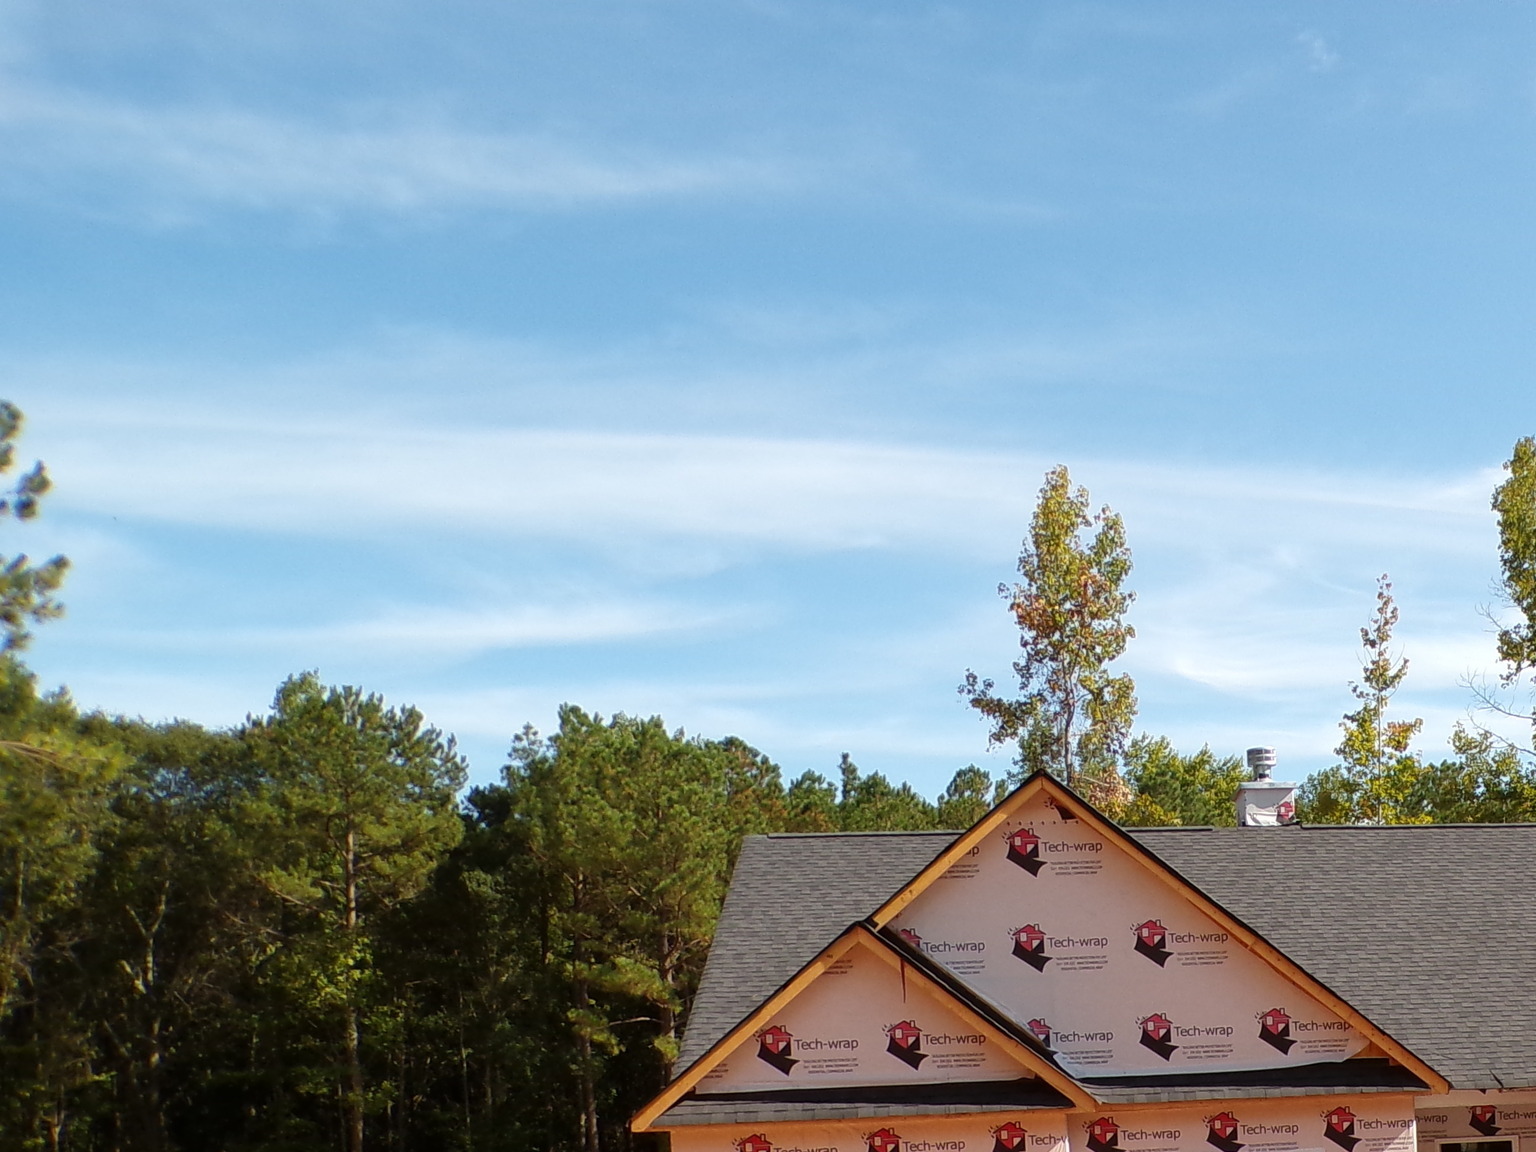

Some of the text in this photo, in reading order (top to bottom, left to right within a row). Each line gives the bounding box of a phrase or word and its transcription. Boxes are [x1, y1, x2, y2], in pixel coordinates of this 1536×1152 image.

[1042, 841, 1103, 853] Tech-wrap
[1048, 937, 1108, 949] Tech-wrap
[1168, 933, 1229, 945] Tech-wrap
[923, 942, 986, 954] Tech-wrap
[1173, 1024, 1234, 1038] Tech-wrap
[1292, 1019, 1351, 1033] Tech-wrap
[924, 1032, 986, 1045] Tech-wrap
[1053, 1030, 1113, 1043] Tech-wrap
[795, 1038, 859, 1051] Tech-wrap
[1240, 1123, 1299, 1136] Tech-wrap
[1357, 1118, 1414, 1131] Tech-wrap
[1120, 1128, 1181, 1141] Tech-wrap
[903, 1140, 966, 1152] Tech-wrap
